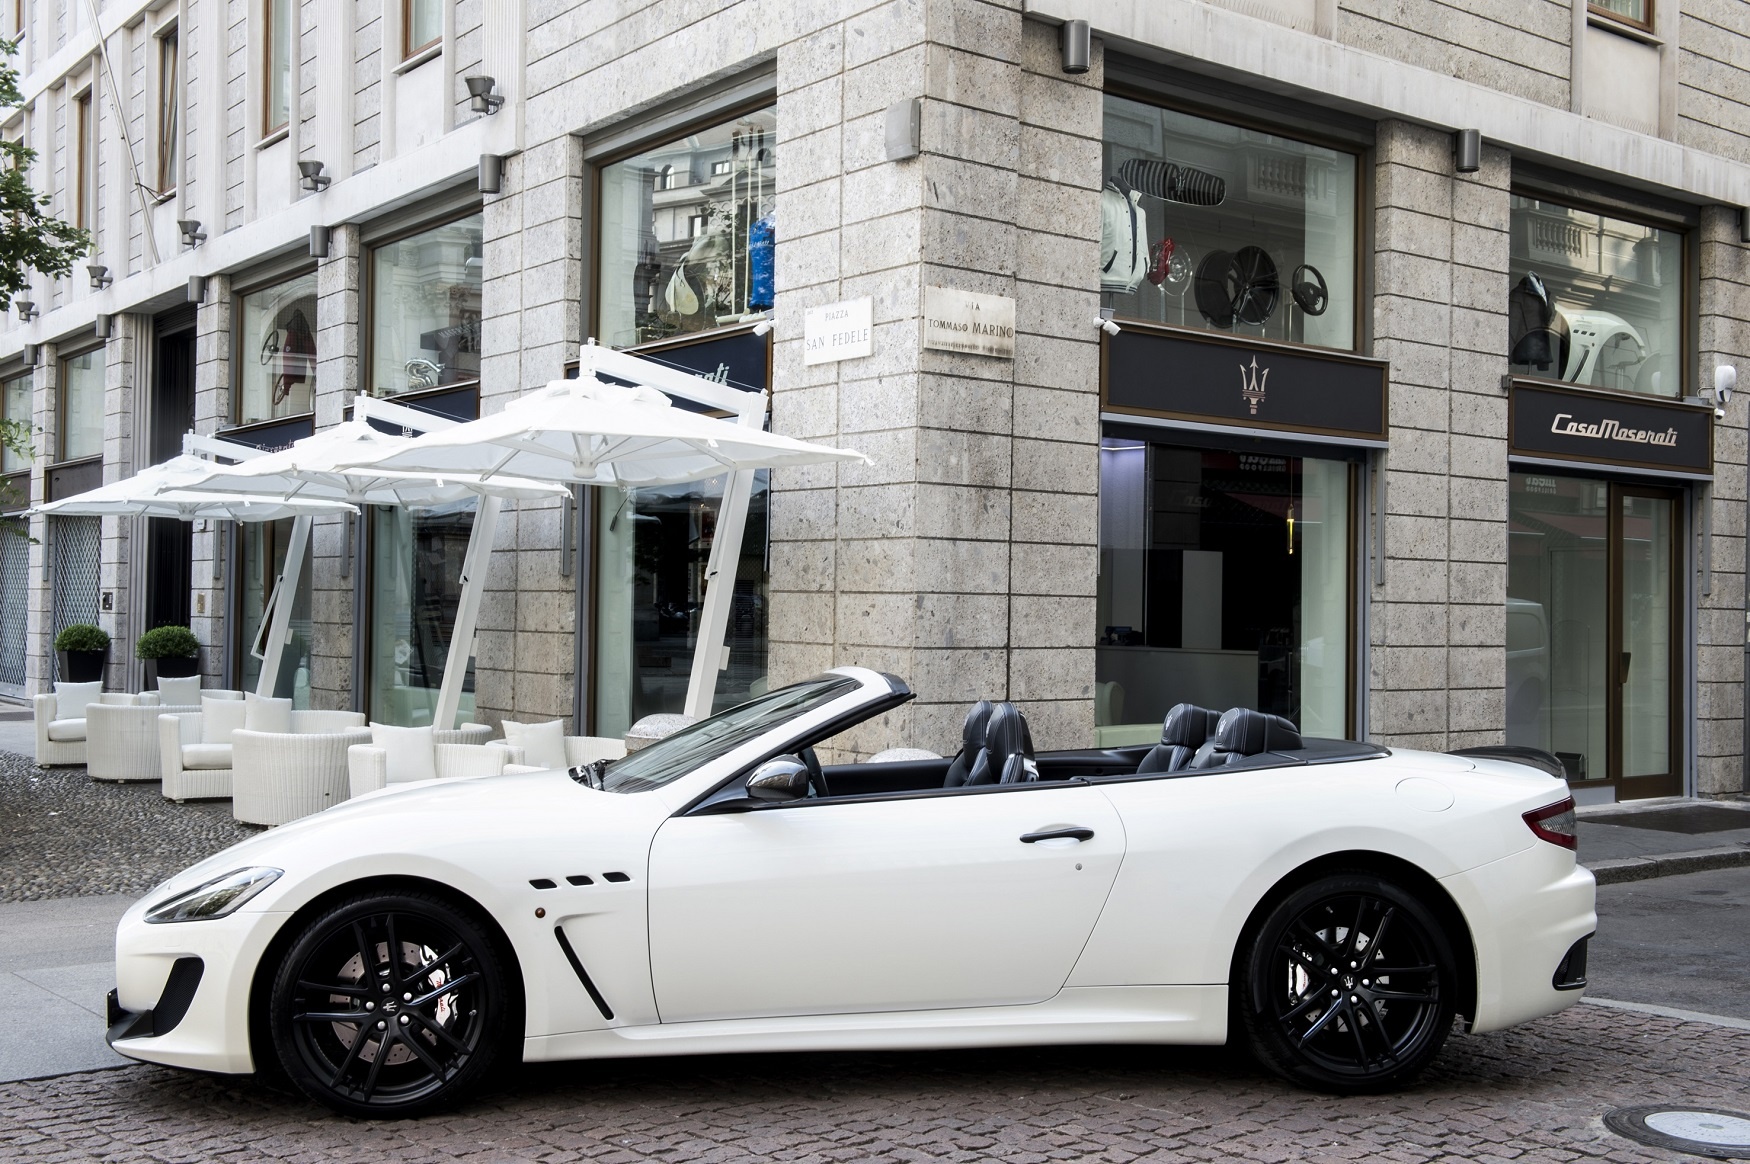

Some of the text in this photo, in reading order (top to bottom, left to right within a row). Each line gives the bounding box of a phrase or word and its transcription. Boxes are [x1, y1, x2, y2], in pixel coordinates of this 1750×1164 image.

[964, 300, 981, 311] VIA
[824, 309, 849, 322] PIAZZA
[928, 318, 1014, 338] TOMMASO MARINO
[806, 328, 869, 351] SAN FEDELE
